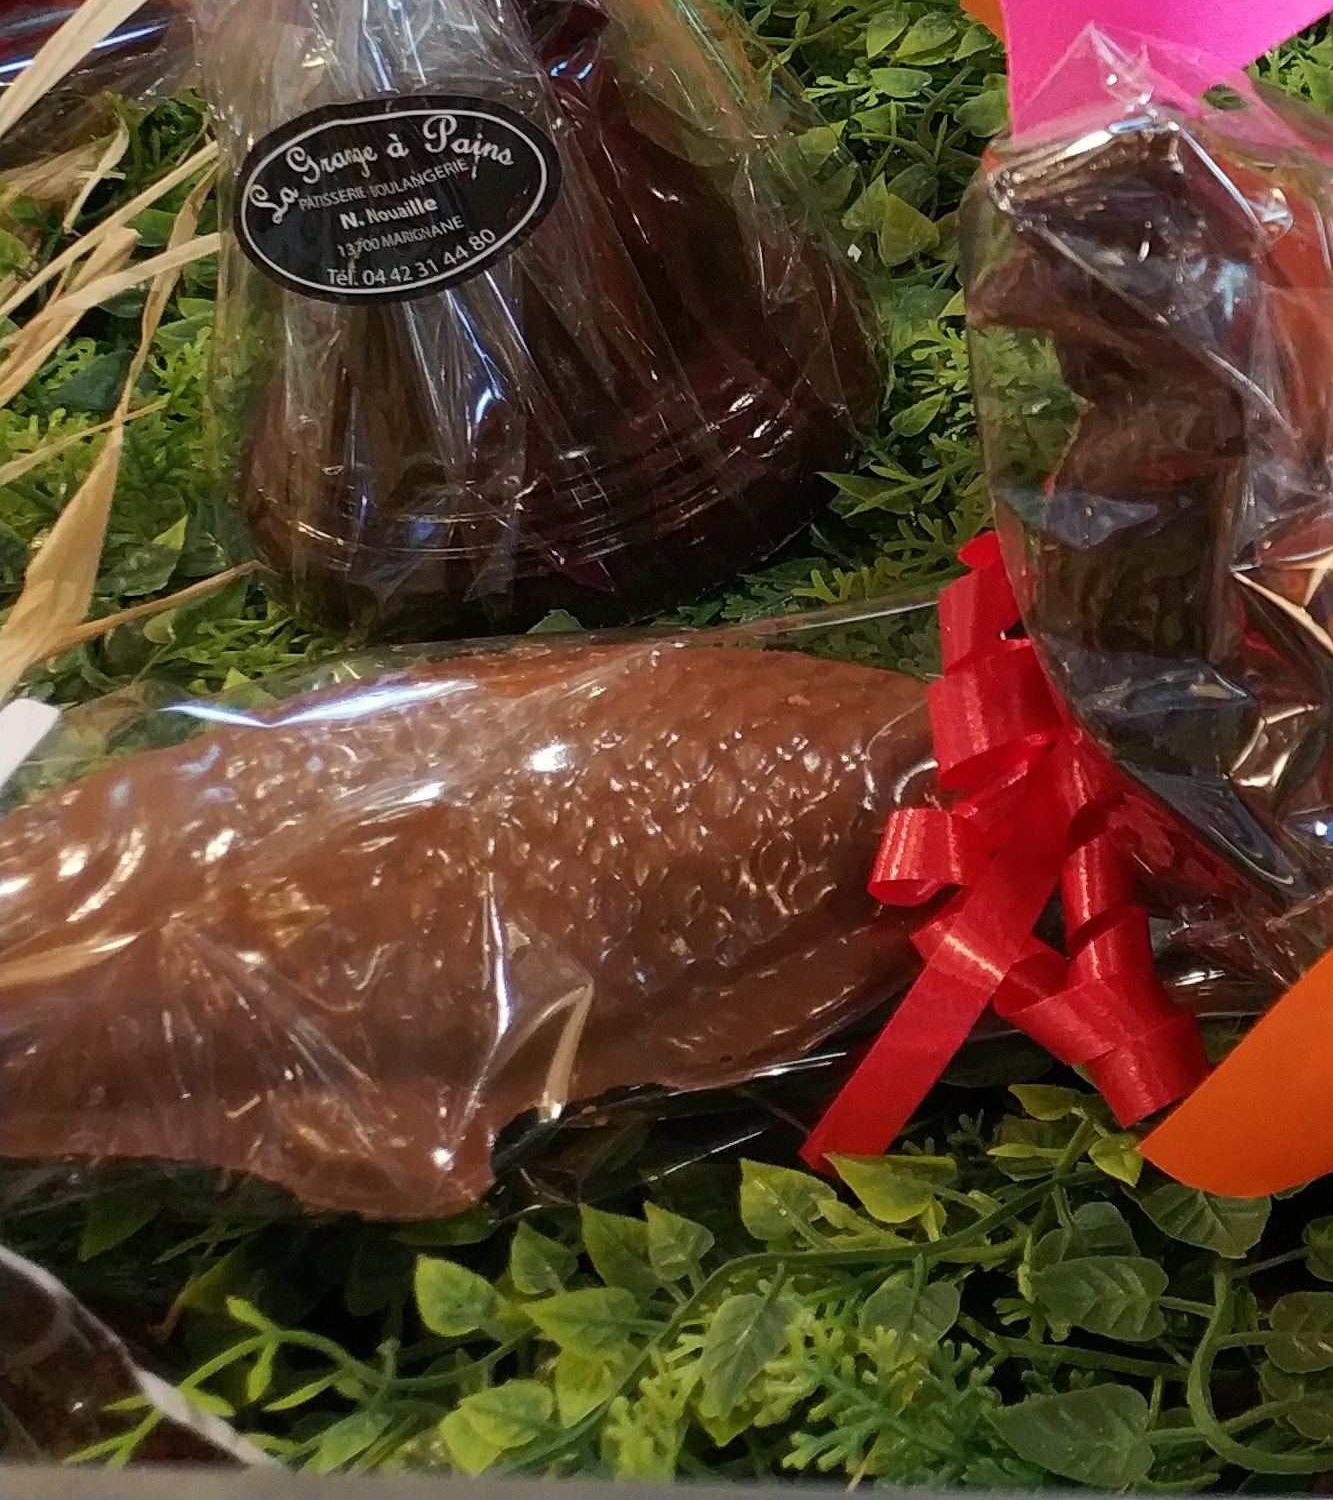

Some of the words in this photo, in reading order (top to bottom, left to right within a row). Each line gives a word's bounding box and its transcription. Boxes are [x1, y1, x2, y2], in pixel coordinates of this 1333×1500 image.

[250, 184, 299, 223] La
[286, 146, 378, 184] Grange
[387, 133, 409, 158] à
[423, 114, 514, 166] Pains
[370, 158, 469, 197] BOULANGERIE
[340, 212, 365, 230] N.
[367, 198, 438, 224] Nouaille
[337, 239, 381, 259] 13700
[382, 215, 465, 248] MARIGNANE
[364, 268, 386, 286] 04
[390, 267, 413, 283] 42
[418, 258, 436, 278] 31
[443, 247, 469, 266] 44
[471, 228, 496, 252] 80
